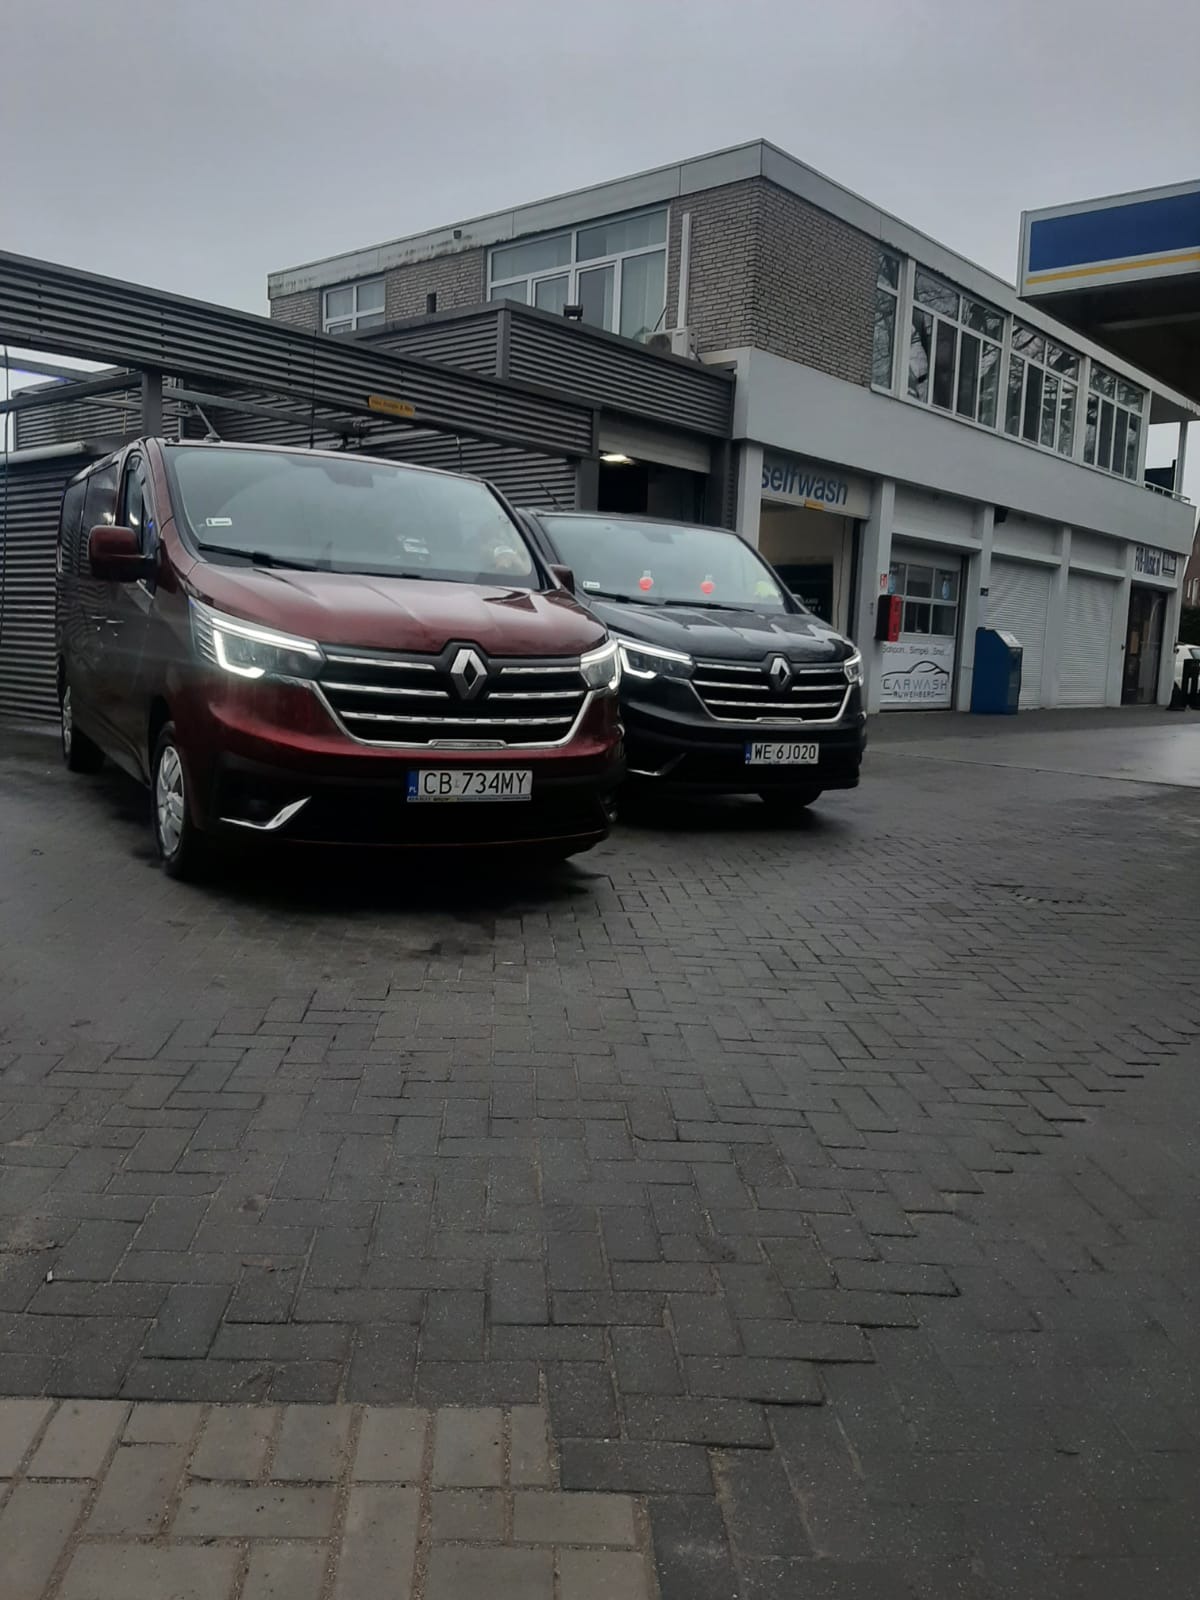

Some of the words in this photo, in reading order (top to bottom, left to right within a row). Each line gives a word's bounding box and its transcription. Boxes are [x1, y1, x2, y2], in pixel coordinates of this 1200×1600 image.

[761, 463, 849, 505] selfwash
[883, 679, 947, 690] CARWASH
[754, 744, 772, 760] WE
[776, 744, 817, 760] 6J020
[424, 772, 452, 794] CB
[461, 772, 527, 794] 734MY
